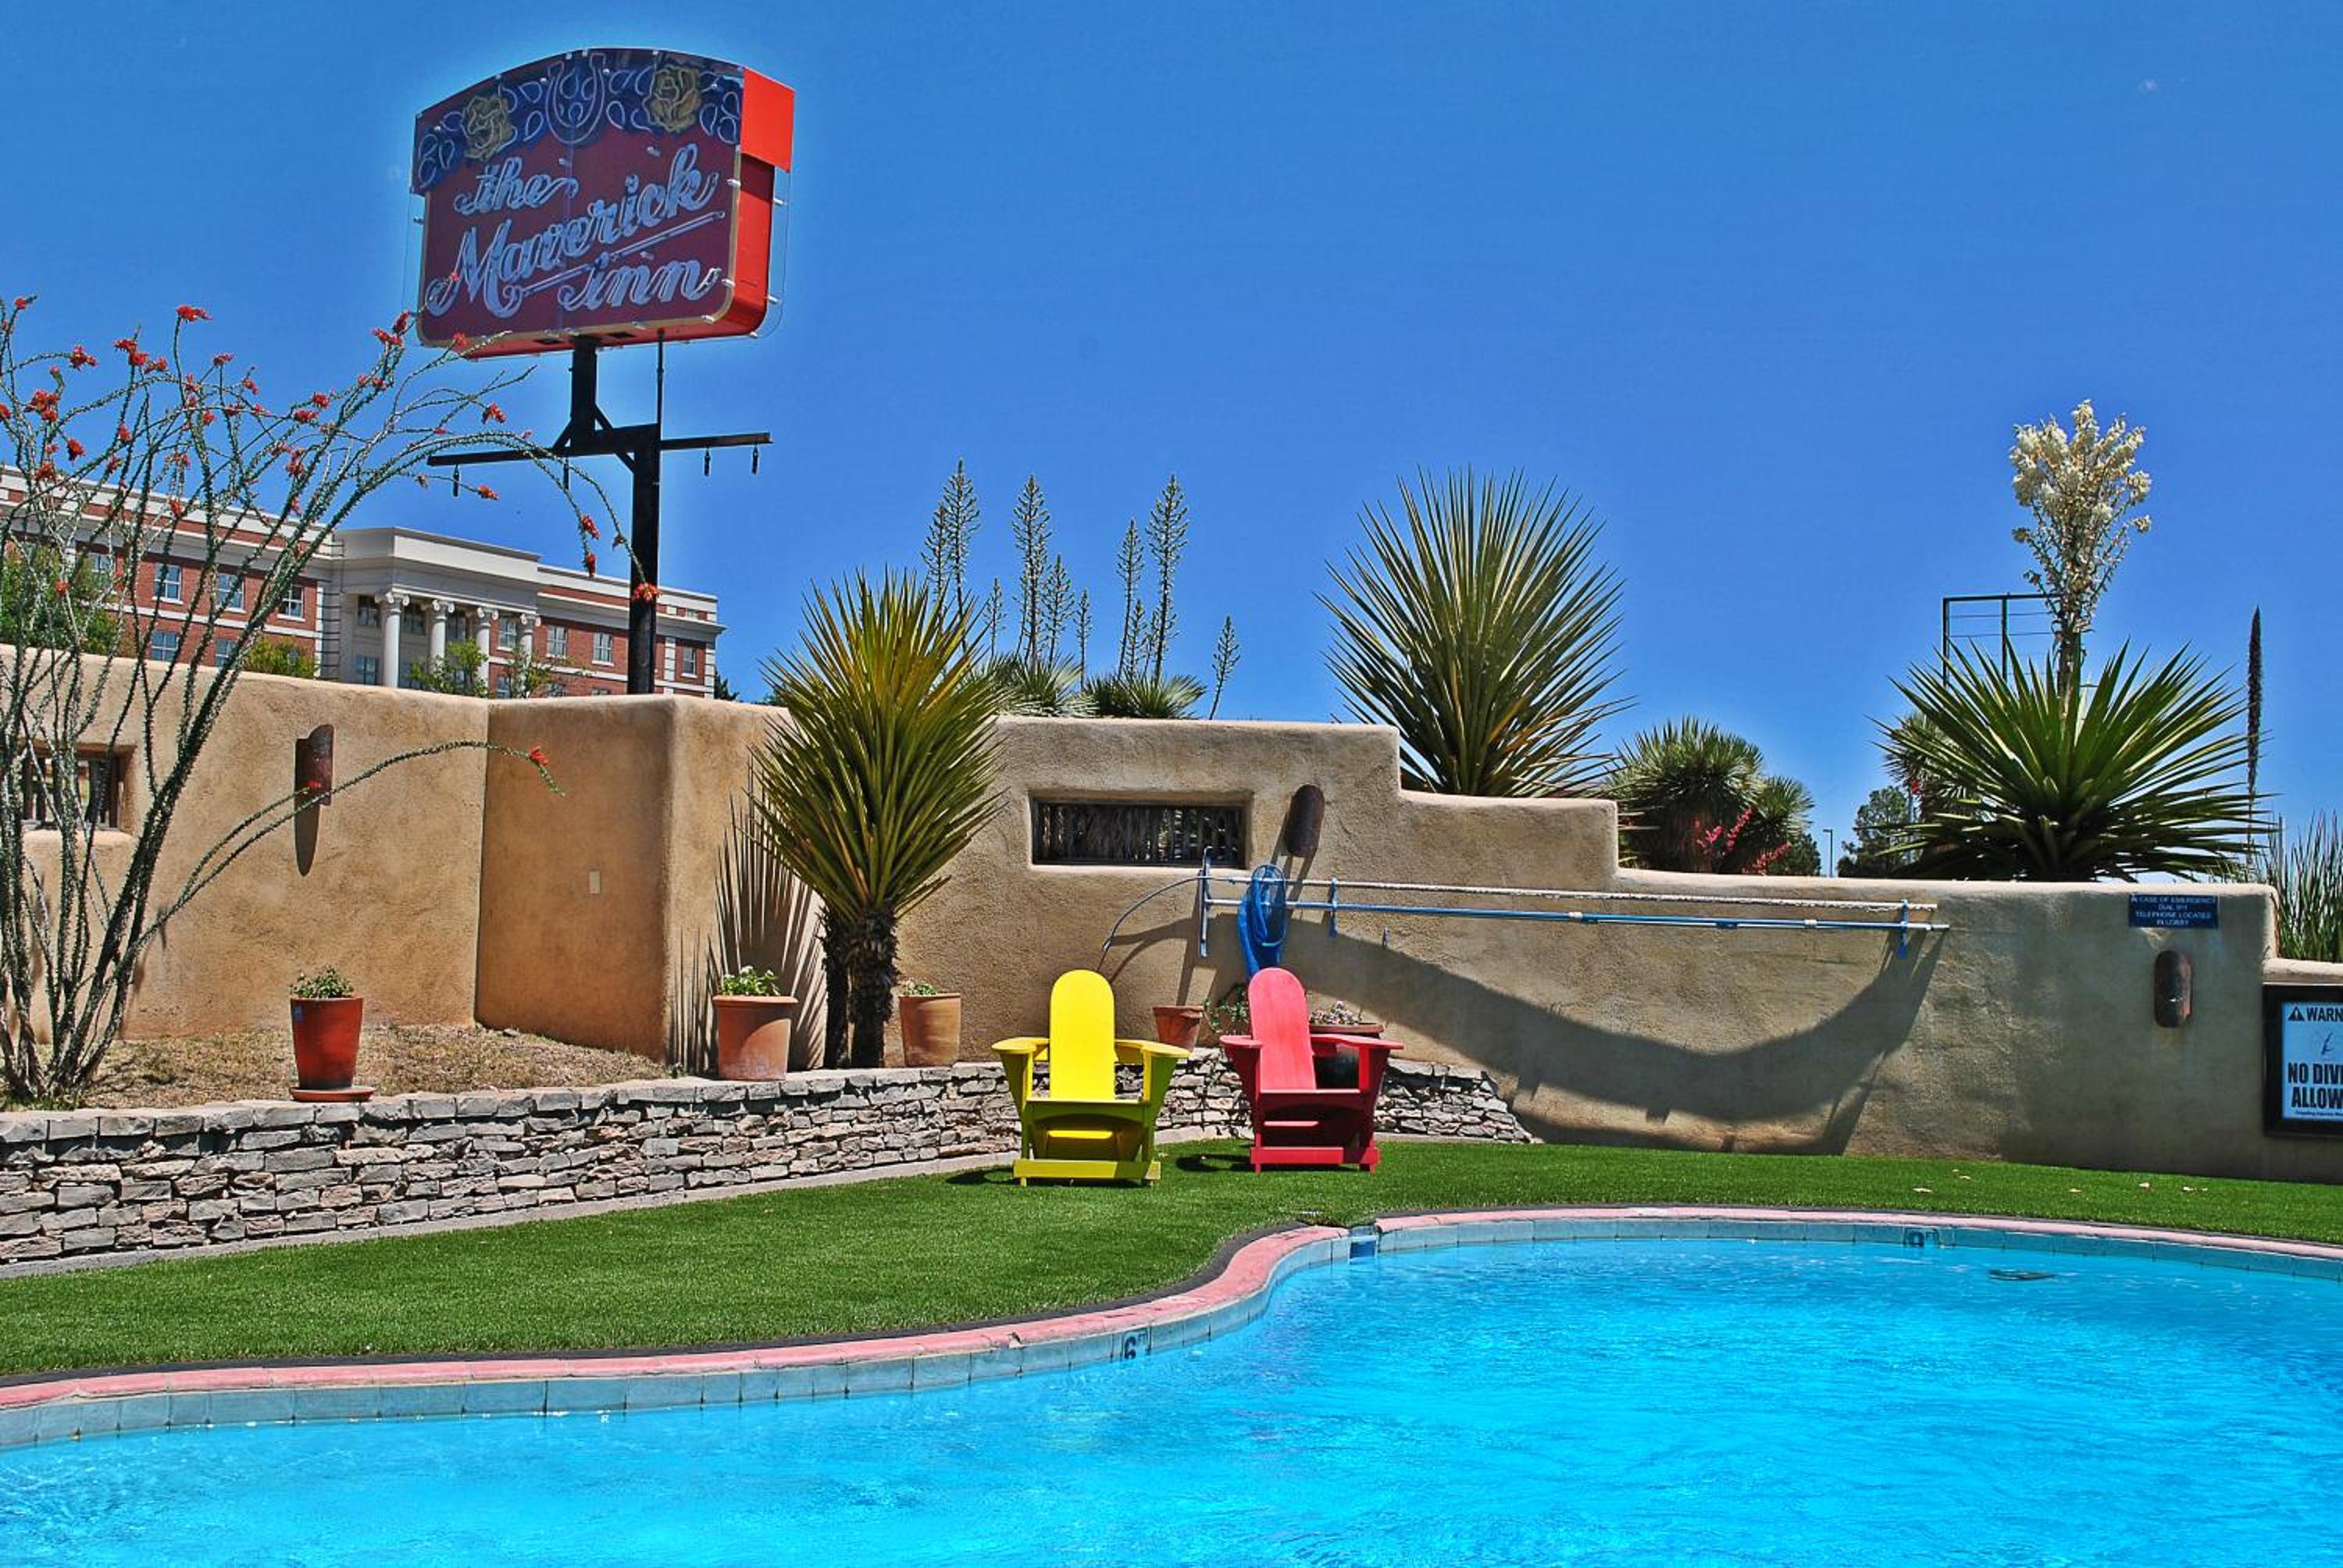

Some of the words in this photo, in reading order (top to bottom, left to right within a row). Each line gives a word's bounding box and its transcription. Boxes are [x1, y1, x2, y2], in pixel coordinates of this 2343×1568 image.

[454, 156, 579, 216] the
[424, 143, 720, 318] Maverick
[2136, 911, 2177, 919] TELEPHONE
[2178, 911, 2212, 920] LOCATED
[2306, 1007, 2343, 1021] WARN
[2288, 1063, 2309, 1084] NO
[2291, 1086, 2343, 1109] ALLOW
